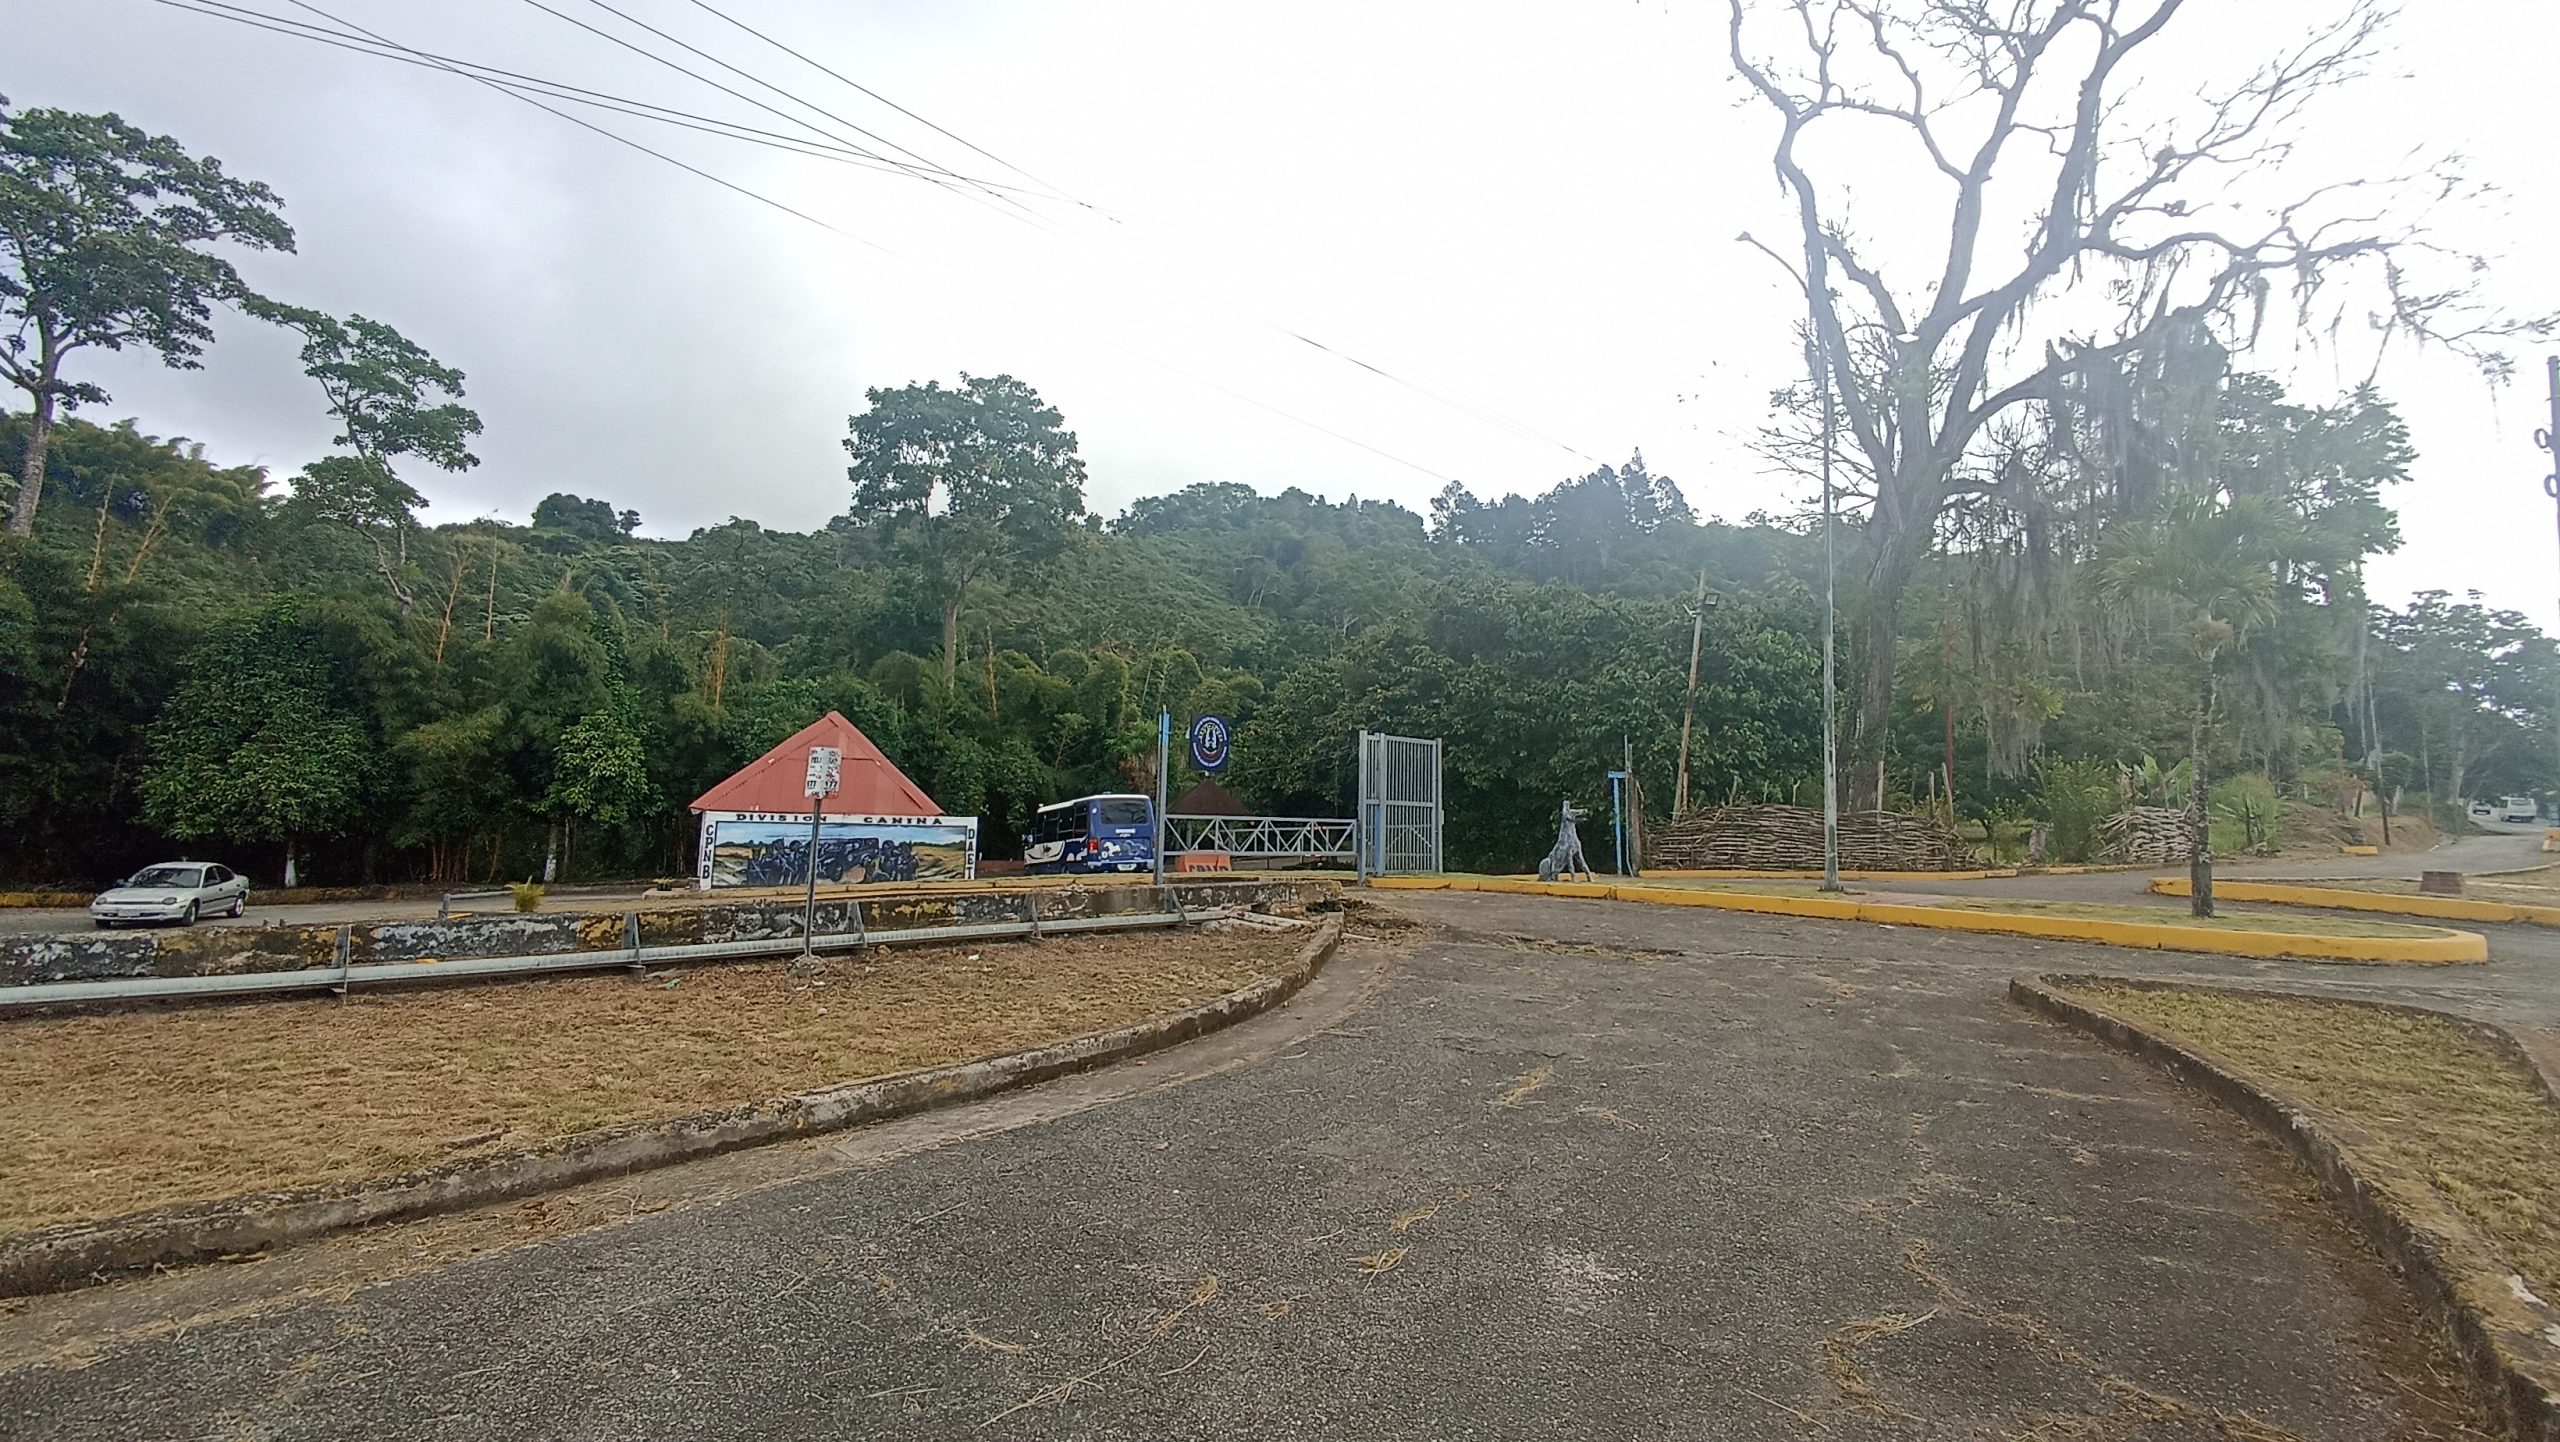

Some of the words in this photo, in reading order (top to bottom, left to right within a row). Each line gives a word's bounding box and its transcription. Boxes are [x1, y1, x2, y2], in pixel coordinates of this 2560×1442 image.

[863, 816, 943, 825] CANINA
[702, 825, 714, 879] CPNB
[967, 828, 975, 880] DAET
